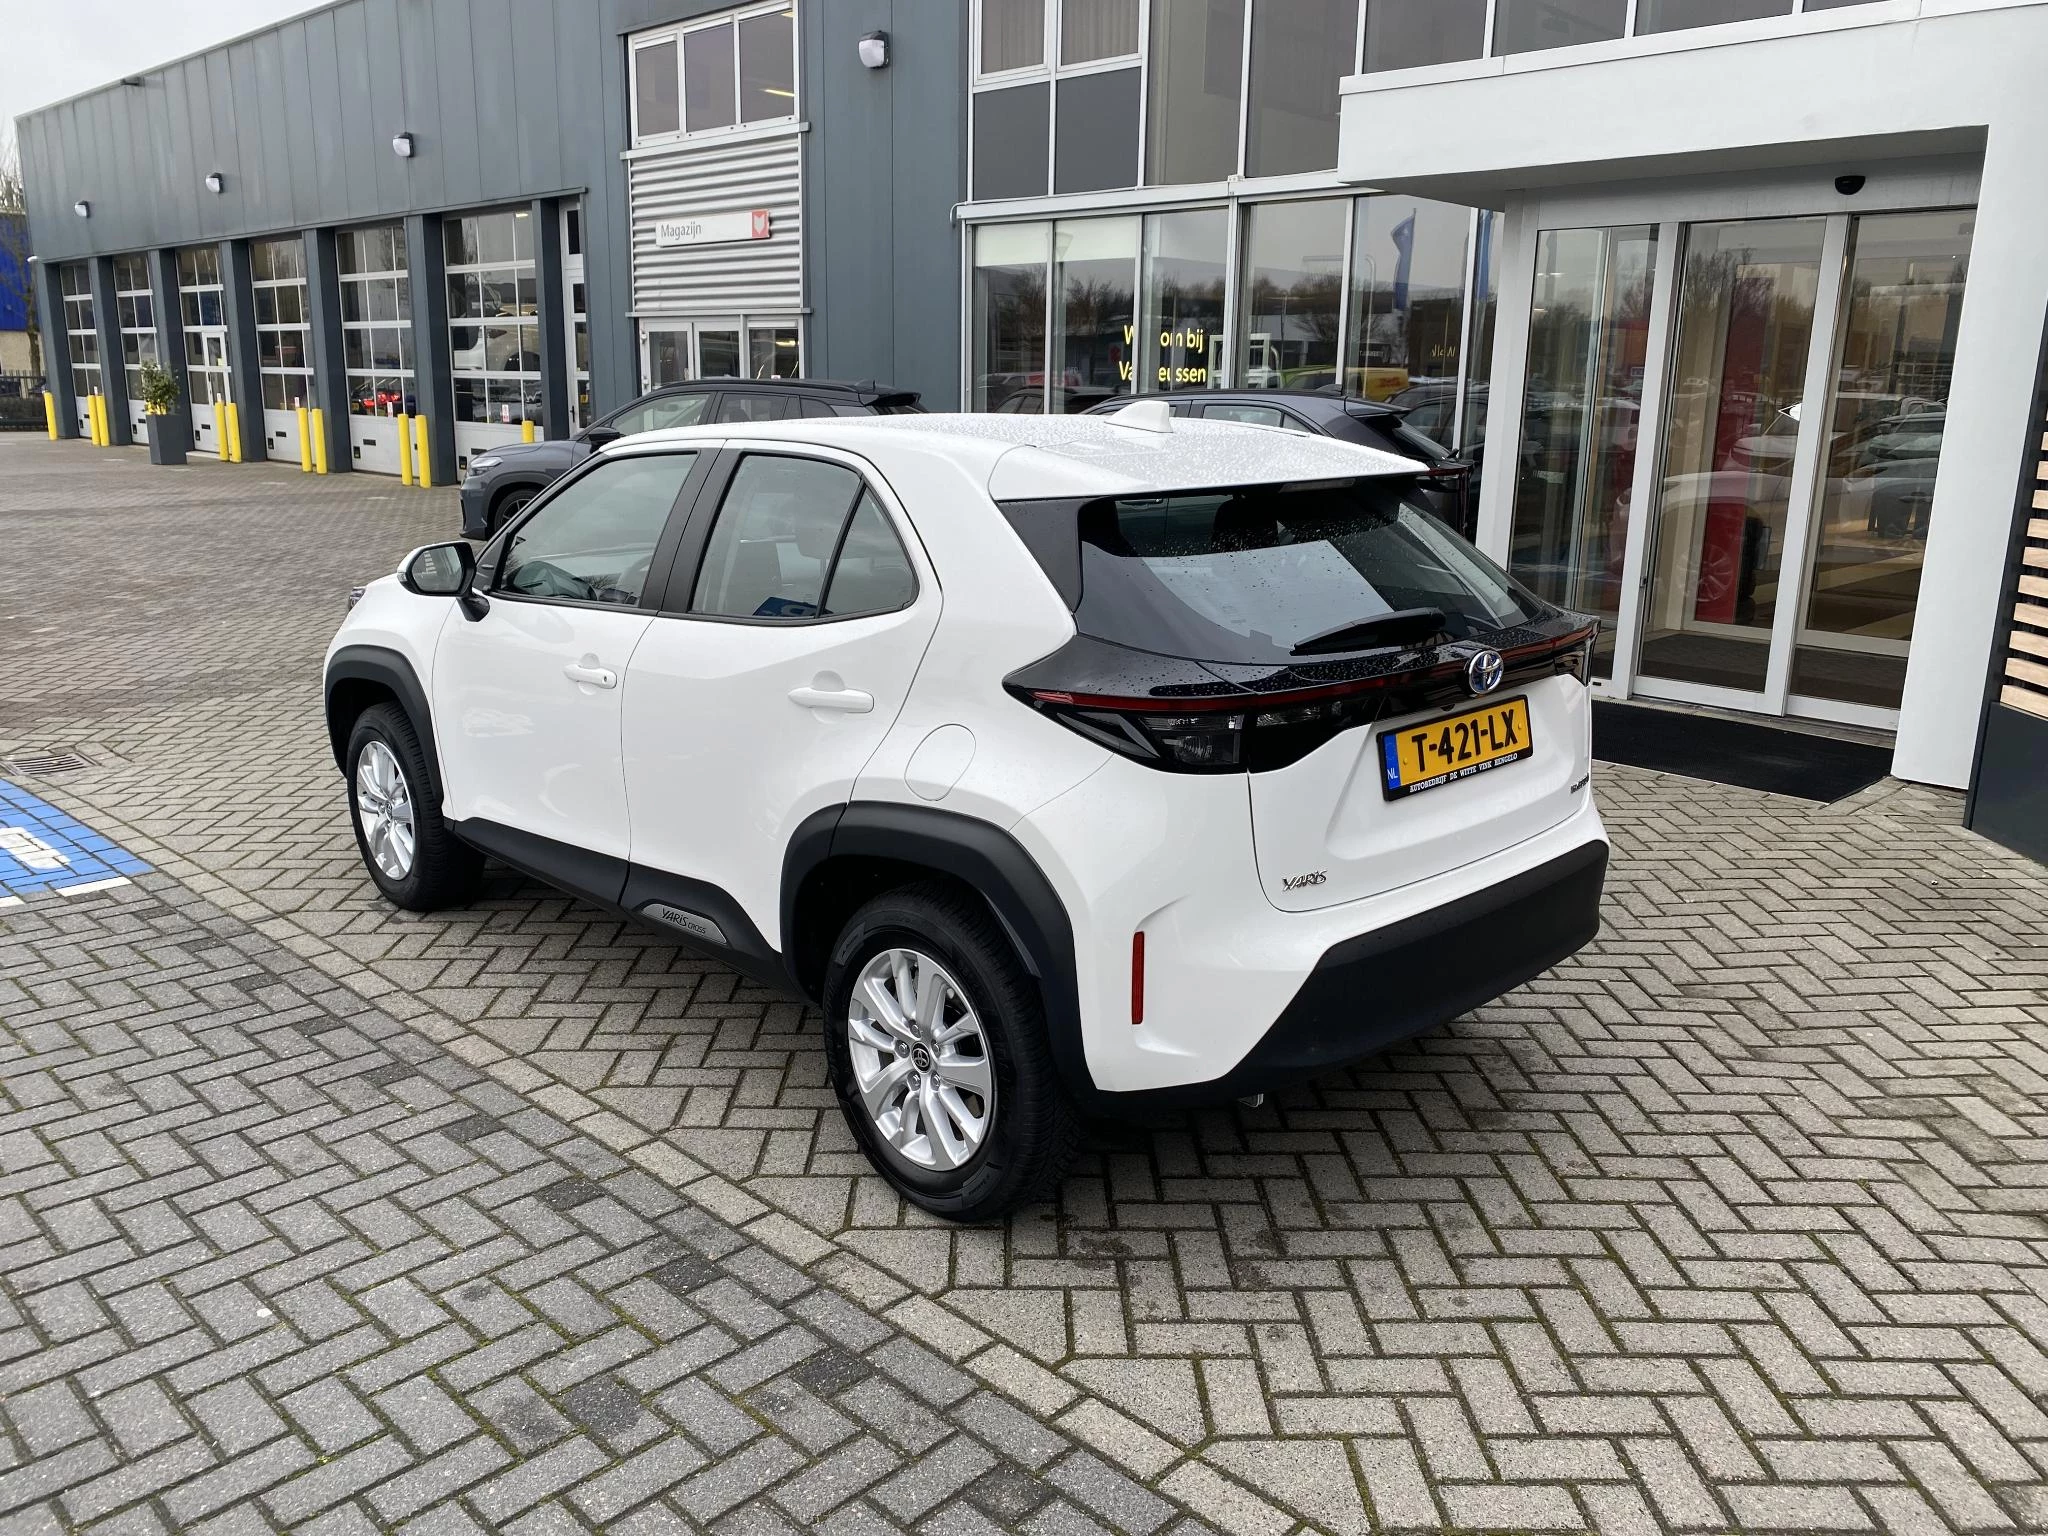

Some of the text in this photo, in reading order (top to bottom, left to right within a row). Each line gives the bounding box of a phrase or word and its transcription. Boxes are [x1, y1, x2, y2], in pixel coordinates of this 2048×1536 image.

[661, 221, 702, 240] Magazijn
[1186, 328, 1204, 354] bij
[1411, 708, 1518, 772] T-421-LX
[1387, 768, 1399, 780] NL
[1409, 752, 1518, 793] AUTOBEDRIJF DE WITTE VINK HENGELO
[687, 922, 706, 934] CROSS
